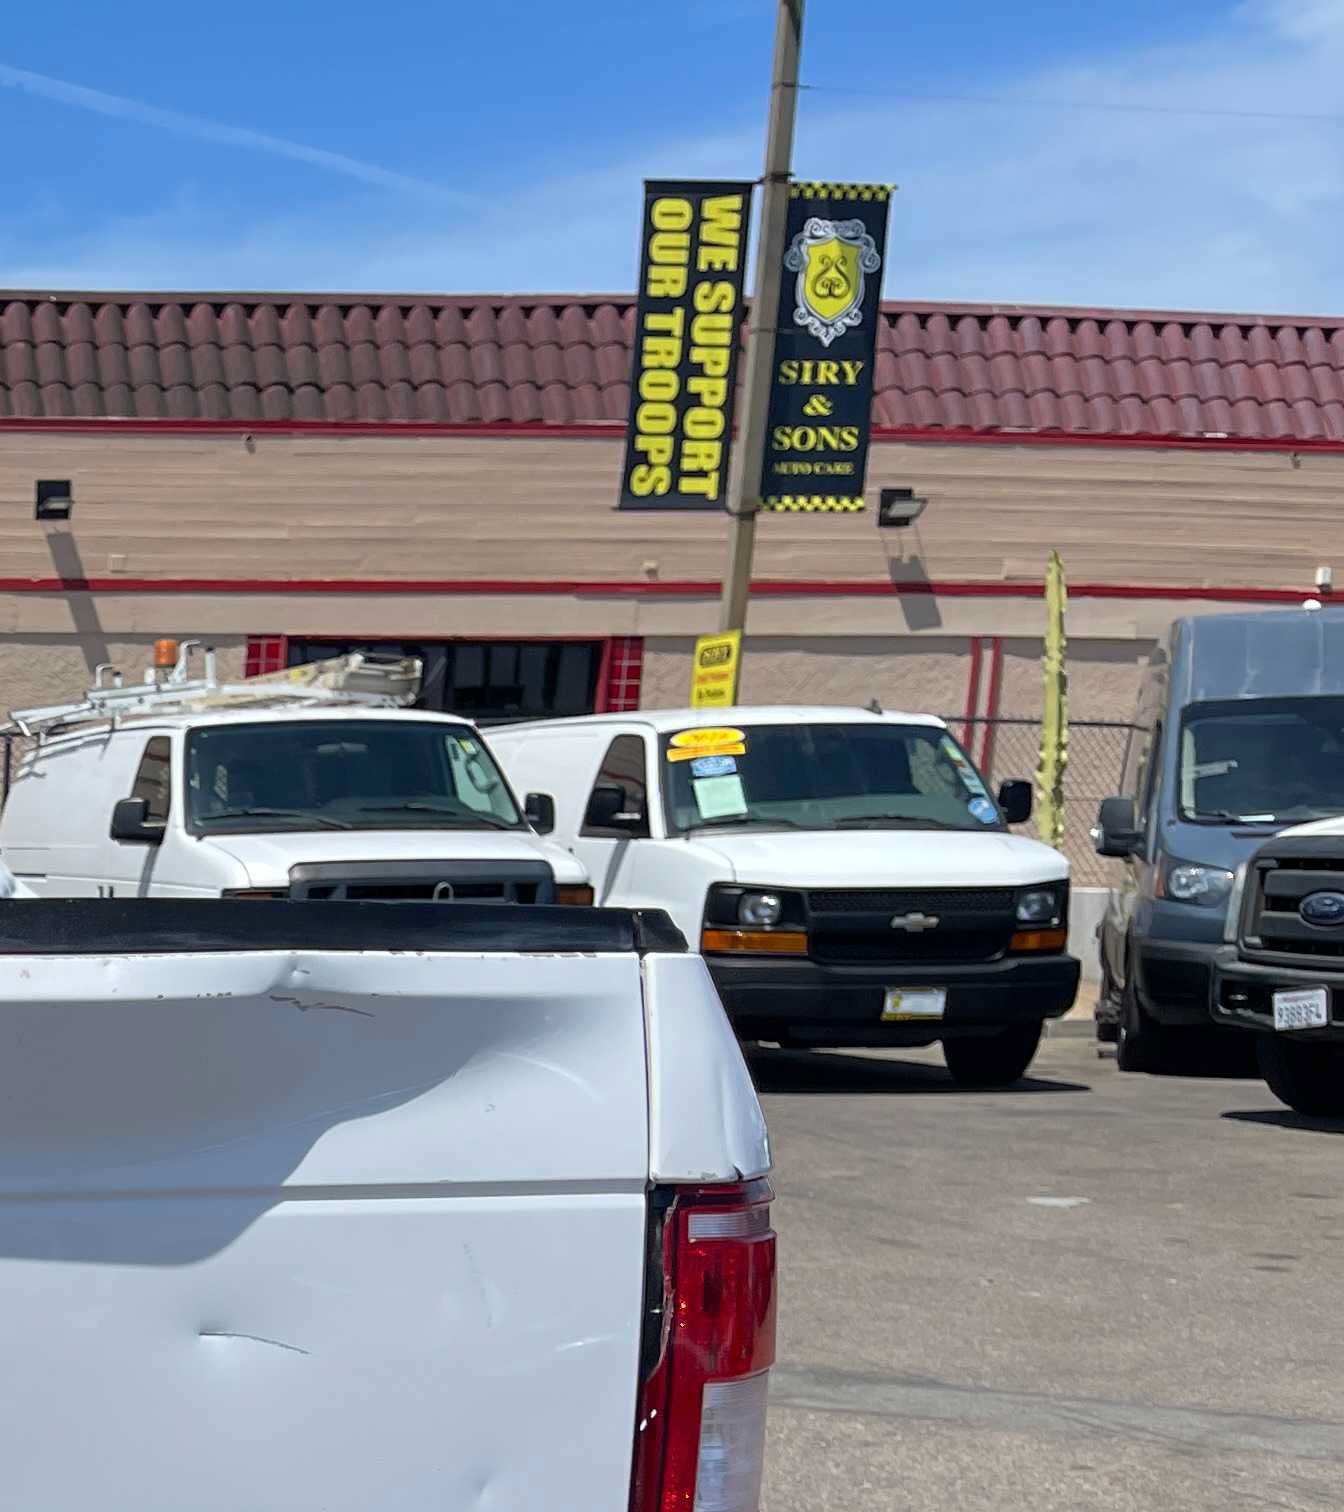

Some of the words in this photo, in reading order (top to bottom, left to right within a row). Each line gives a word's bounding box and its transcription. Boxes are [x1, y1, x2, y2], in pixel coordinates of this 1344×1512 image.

[647, 197, 693, 299] OUR
[696, 194, 743, 272] WE
[630, 307, 685, 497] TROOPS
[678, 280, 736, 500] SUPPORT
[778, 360, 864, 385] SIRY
[802, 394, 832, 417] &
[772, 426, 859, 451] SONS
